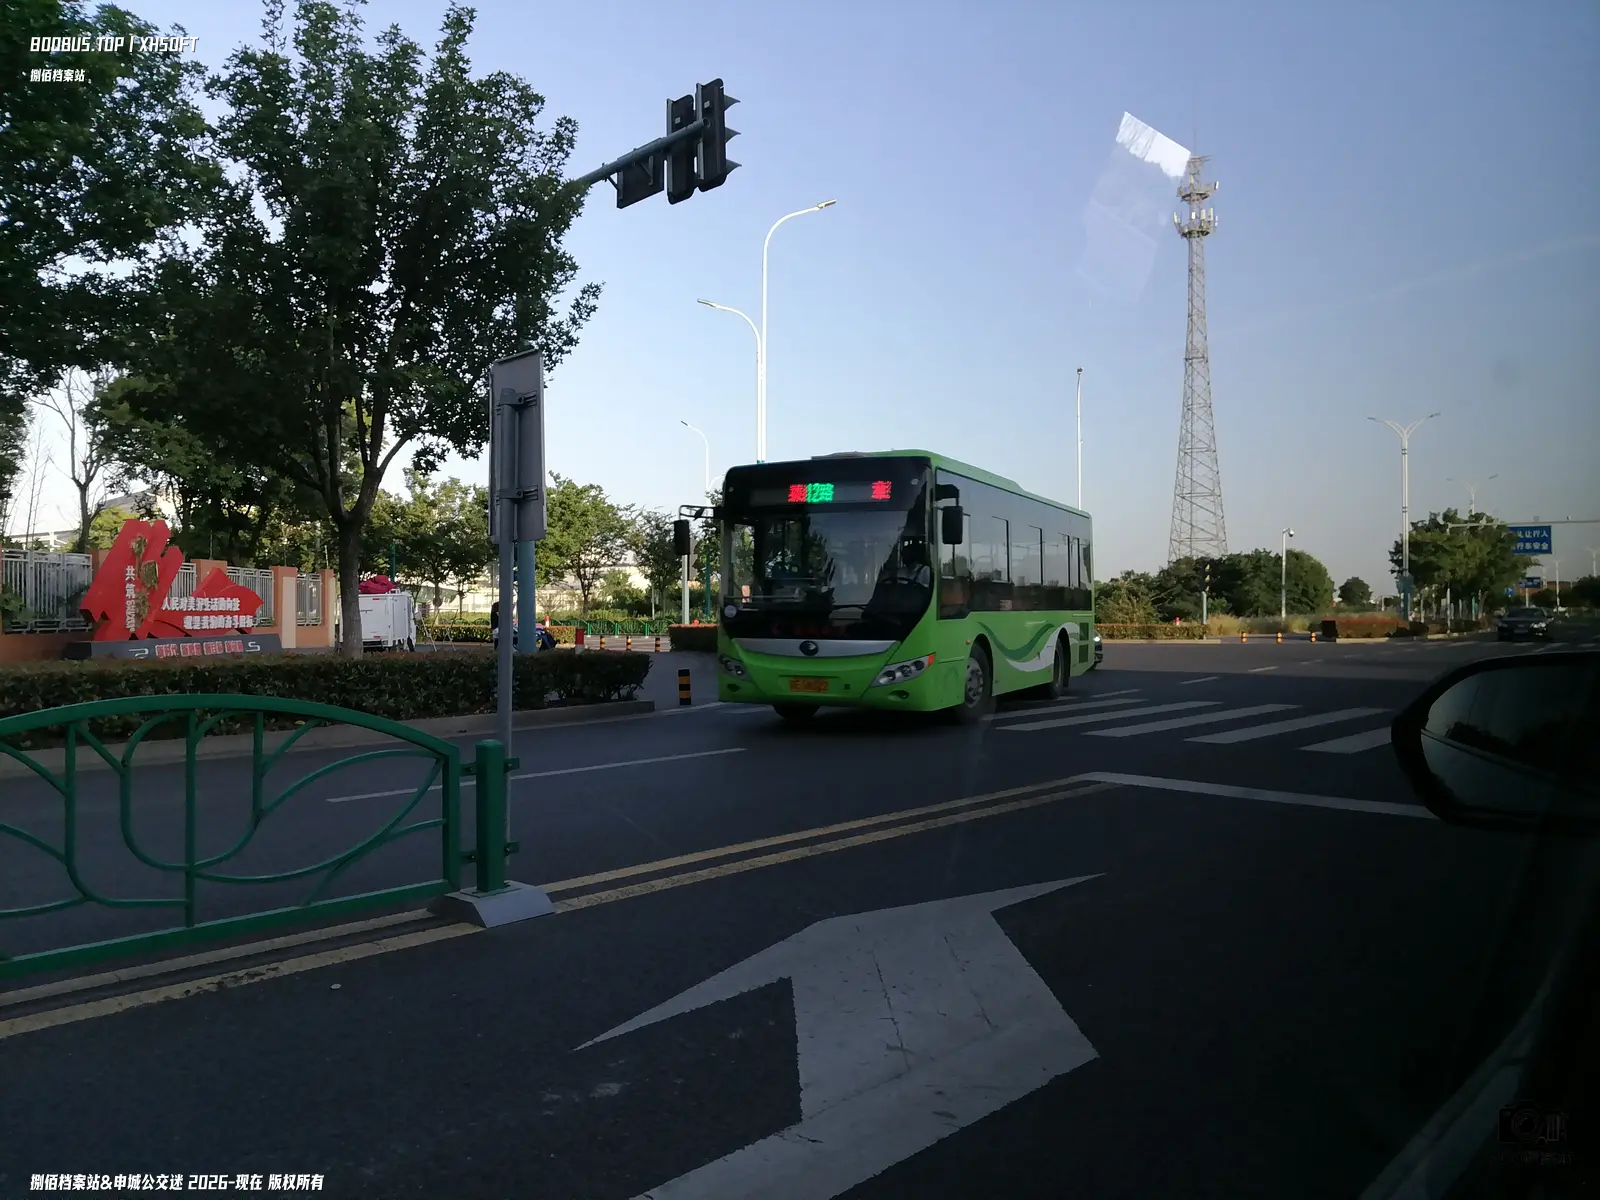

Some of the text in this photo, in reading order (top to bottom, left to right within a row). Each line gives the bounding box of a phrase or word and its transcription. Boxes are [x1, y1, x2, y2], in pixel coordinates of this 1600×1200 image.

[161, 596, 241, 611] 人民对美好生活的向往
